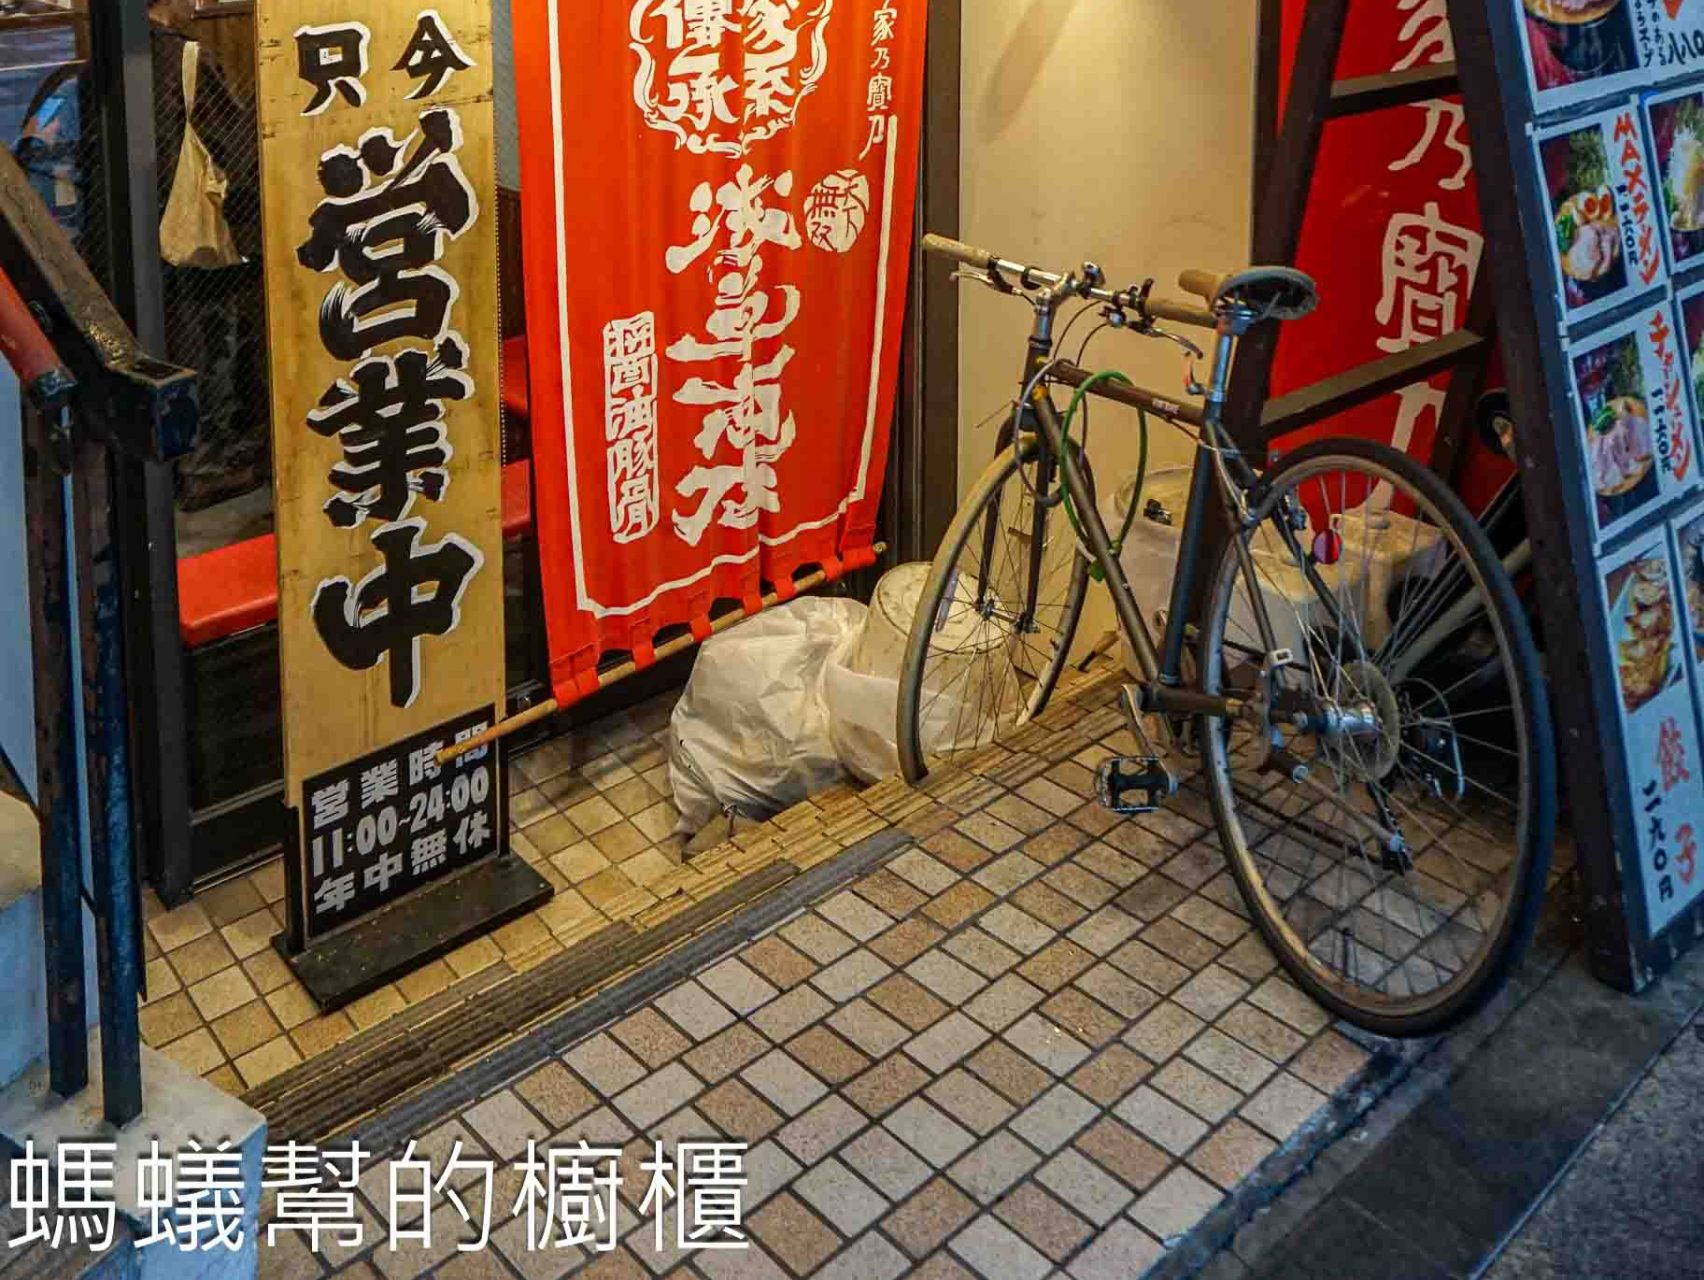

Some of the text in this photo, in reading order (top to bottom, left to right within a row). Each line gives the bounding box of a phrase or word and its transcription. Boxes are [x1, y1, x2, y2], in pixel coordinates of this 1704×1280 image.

[293, 7, 475, 117] 只今
[295, 105, 480, 710] 営業中
[313, 810, 492, 915] 年中無休
